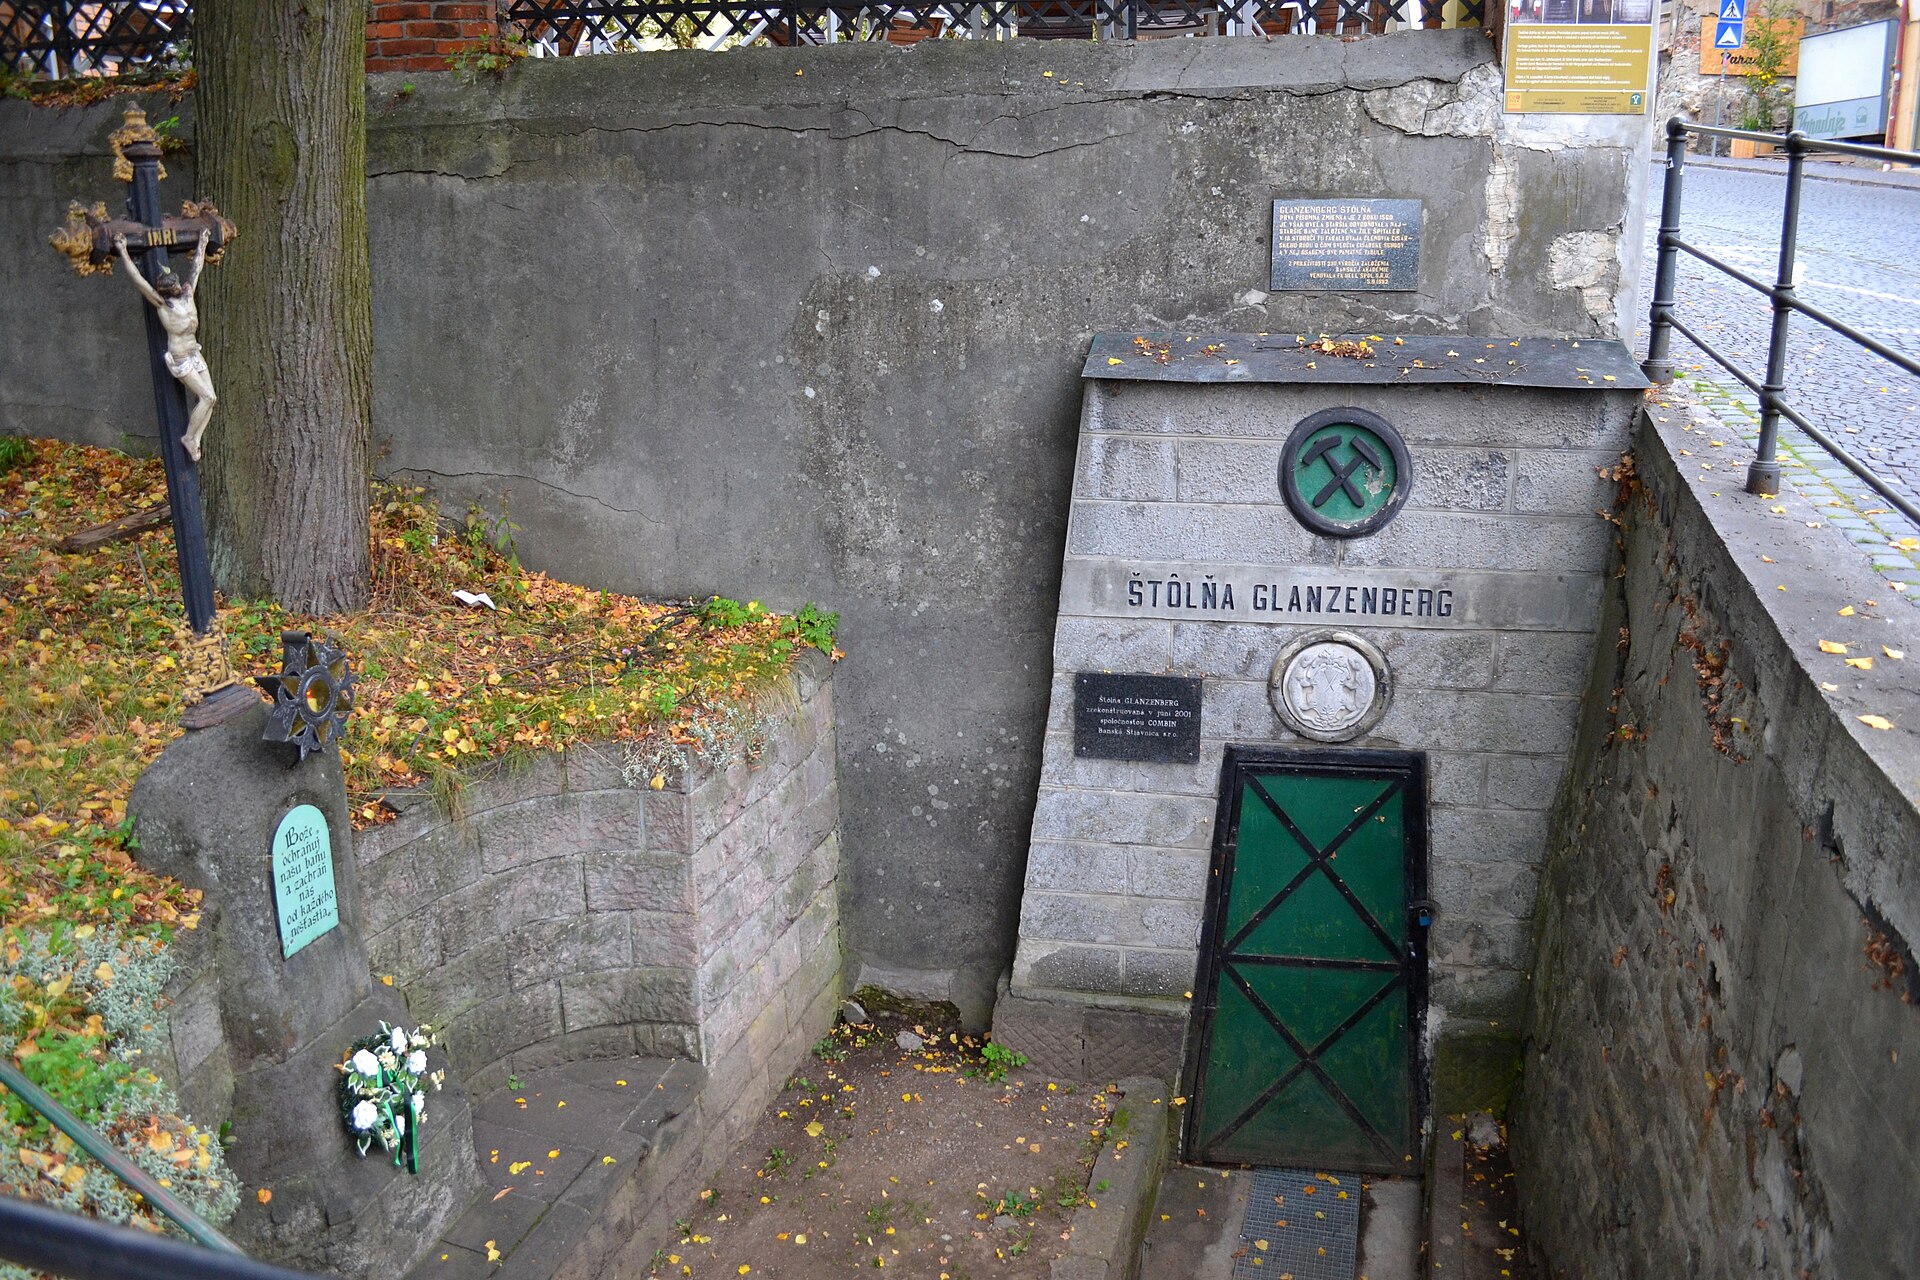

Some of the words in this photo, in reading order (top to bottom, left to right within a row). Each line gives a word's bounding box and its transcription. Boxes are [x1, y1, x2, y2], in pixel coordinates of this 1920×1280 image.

[1279, 205, 1337, 214] GLANZENBERG
[147, 228, 178, 247] INRI
[1127, 572, 1235, 611] ŠTÔLŇA
[1252, 583, 1454, 618] GLANZENBERG
[1124, 697, 1179, 707] GLANZENBERG
[1174, 710, 1192, 718] 2001
[1147, 719, 1177, 728] COMBIN
[1098, 726, 1122, 736] Banská
[280, 864, 302, 883] našu
[285, 885, 292, 896] a
[299, 886, 315, 902] nás
[286, 909, 299, 925] od
